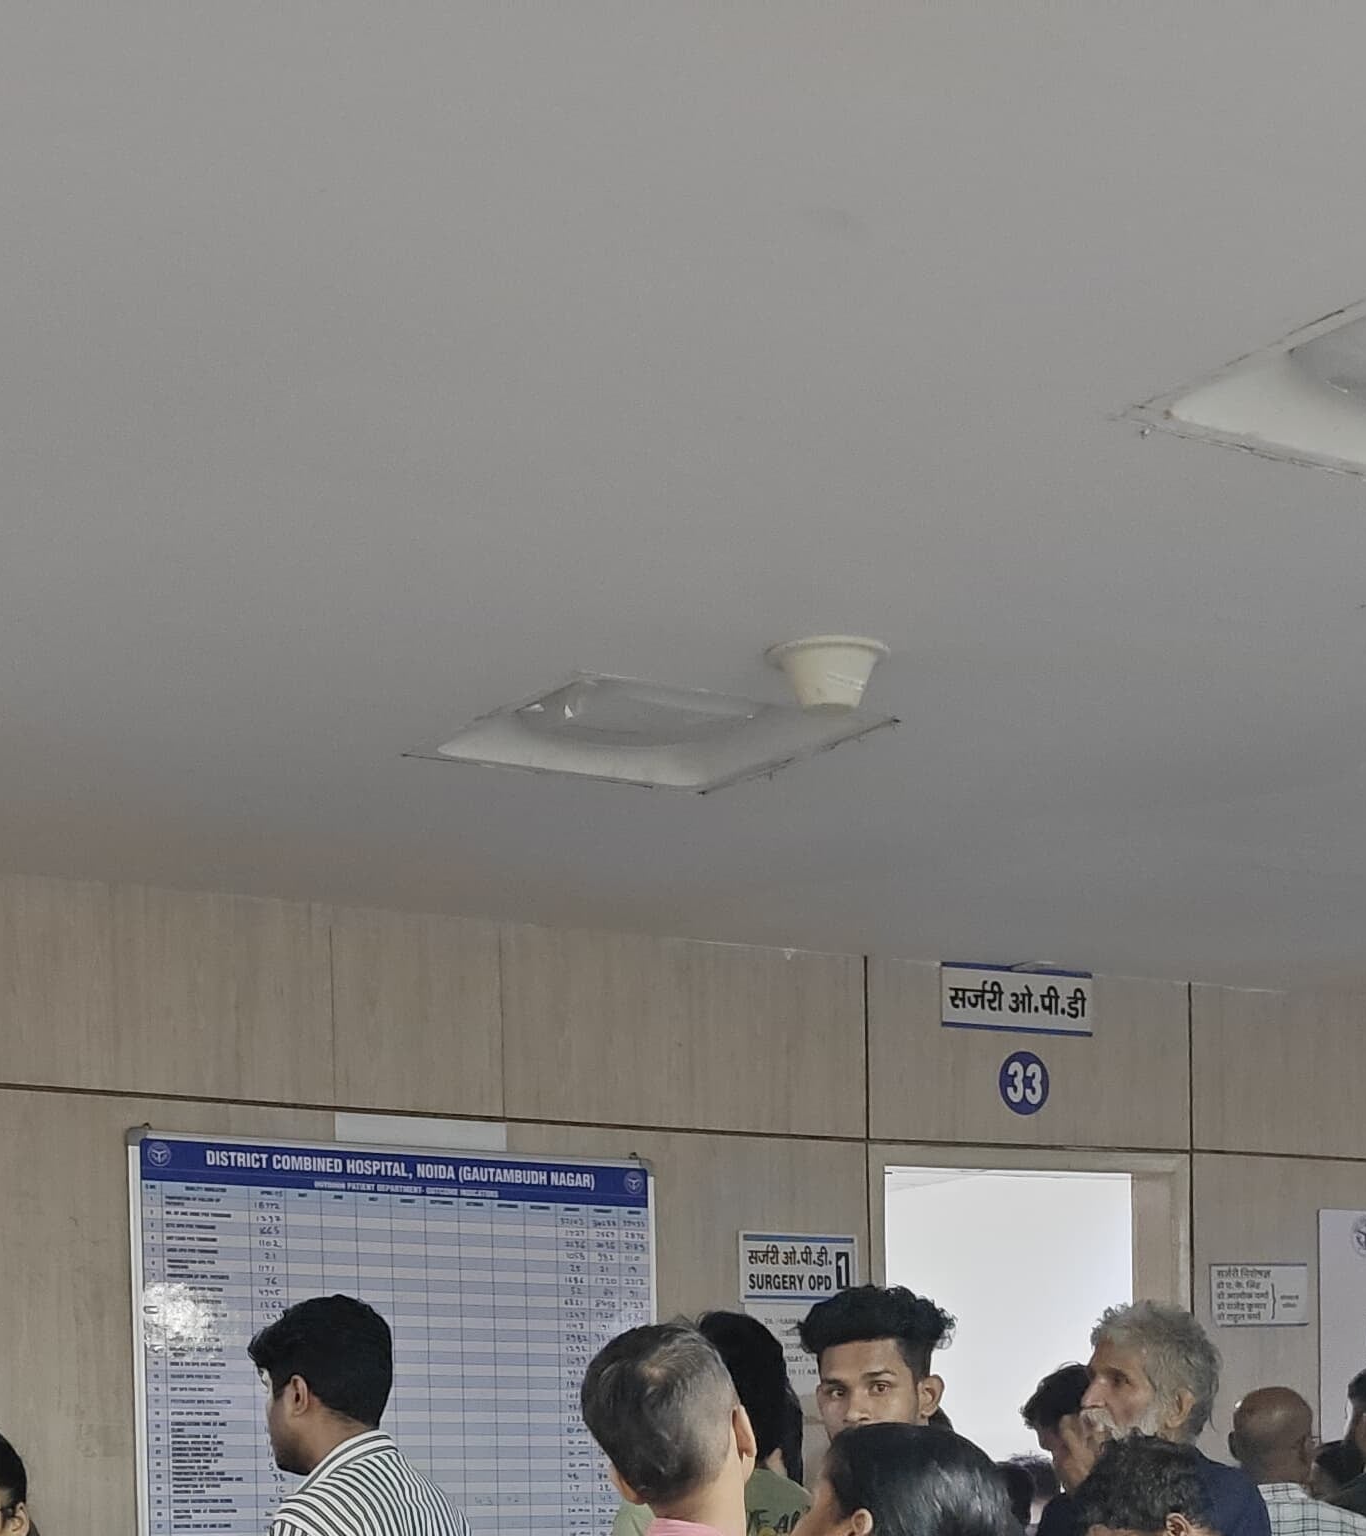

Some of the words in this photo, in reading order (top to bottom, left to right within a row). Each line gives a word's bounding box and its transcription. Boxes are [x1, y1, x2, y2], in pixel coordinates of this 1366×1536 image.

[949, 980, 1003, 1012] सर्जरी
[1008, 985, 1086, 1018] ओ.पी.डी
[1006, 1061, 1042, 1105] 33
[206, 1150, 268, 1168] DISTRICT
[272, 1154, 343, 1173] COMBINED
[346, 1158, 413, 1180] HOSPITAL,
[417, 1163, 455, 1180] NOIDA
[458, 1166, 547, 1186] (GAUTAMBUDH
[550, 1171, 595, 1191] NAGAR)
[748, 1243, 780, 1265] सर्जरी
[782, 1246, 832, 1267] ओ.पी.डी.
[748, 1273, 805, 1291] SURGERY
[808, 1274, 832, 1291] OPD
